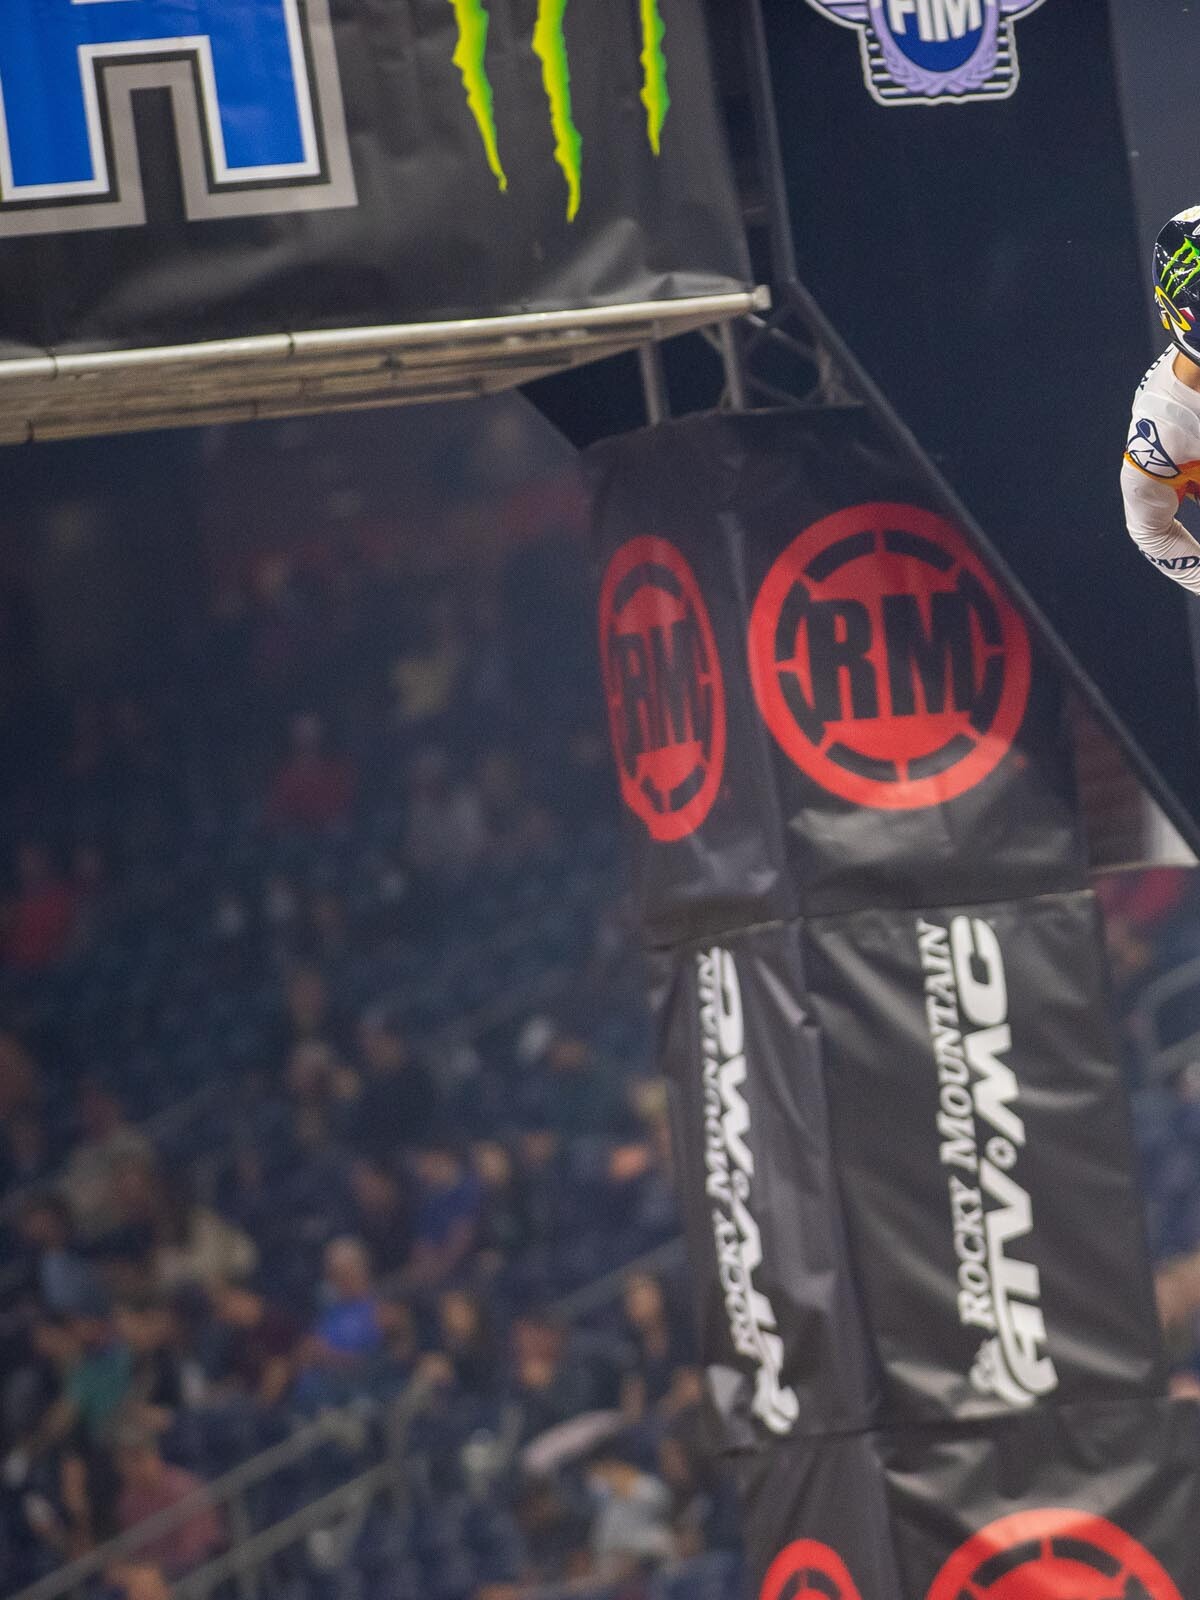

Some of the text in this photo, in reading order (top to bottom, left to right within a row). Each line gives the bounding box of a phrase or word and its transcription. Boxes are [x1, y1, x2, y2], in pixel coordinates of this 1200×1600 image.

[806, 592, 976, 724] RM
[916, 918, 998, 1333] ROCKY MOUNTAIN
[712, 1207, 762, 1359] ROCKY
